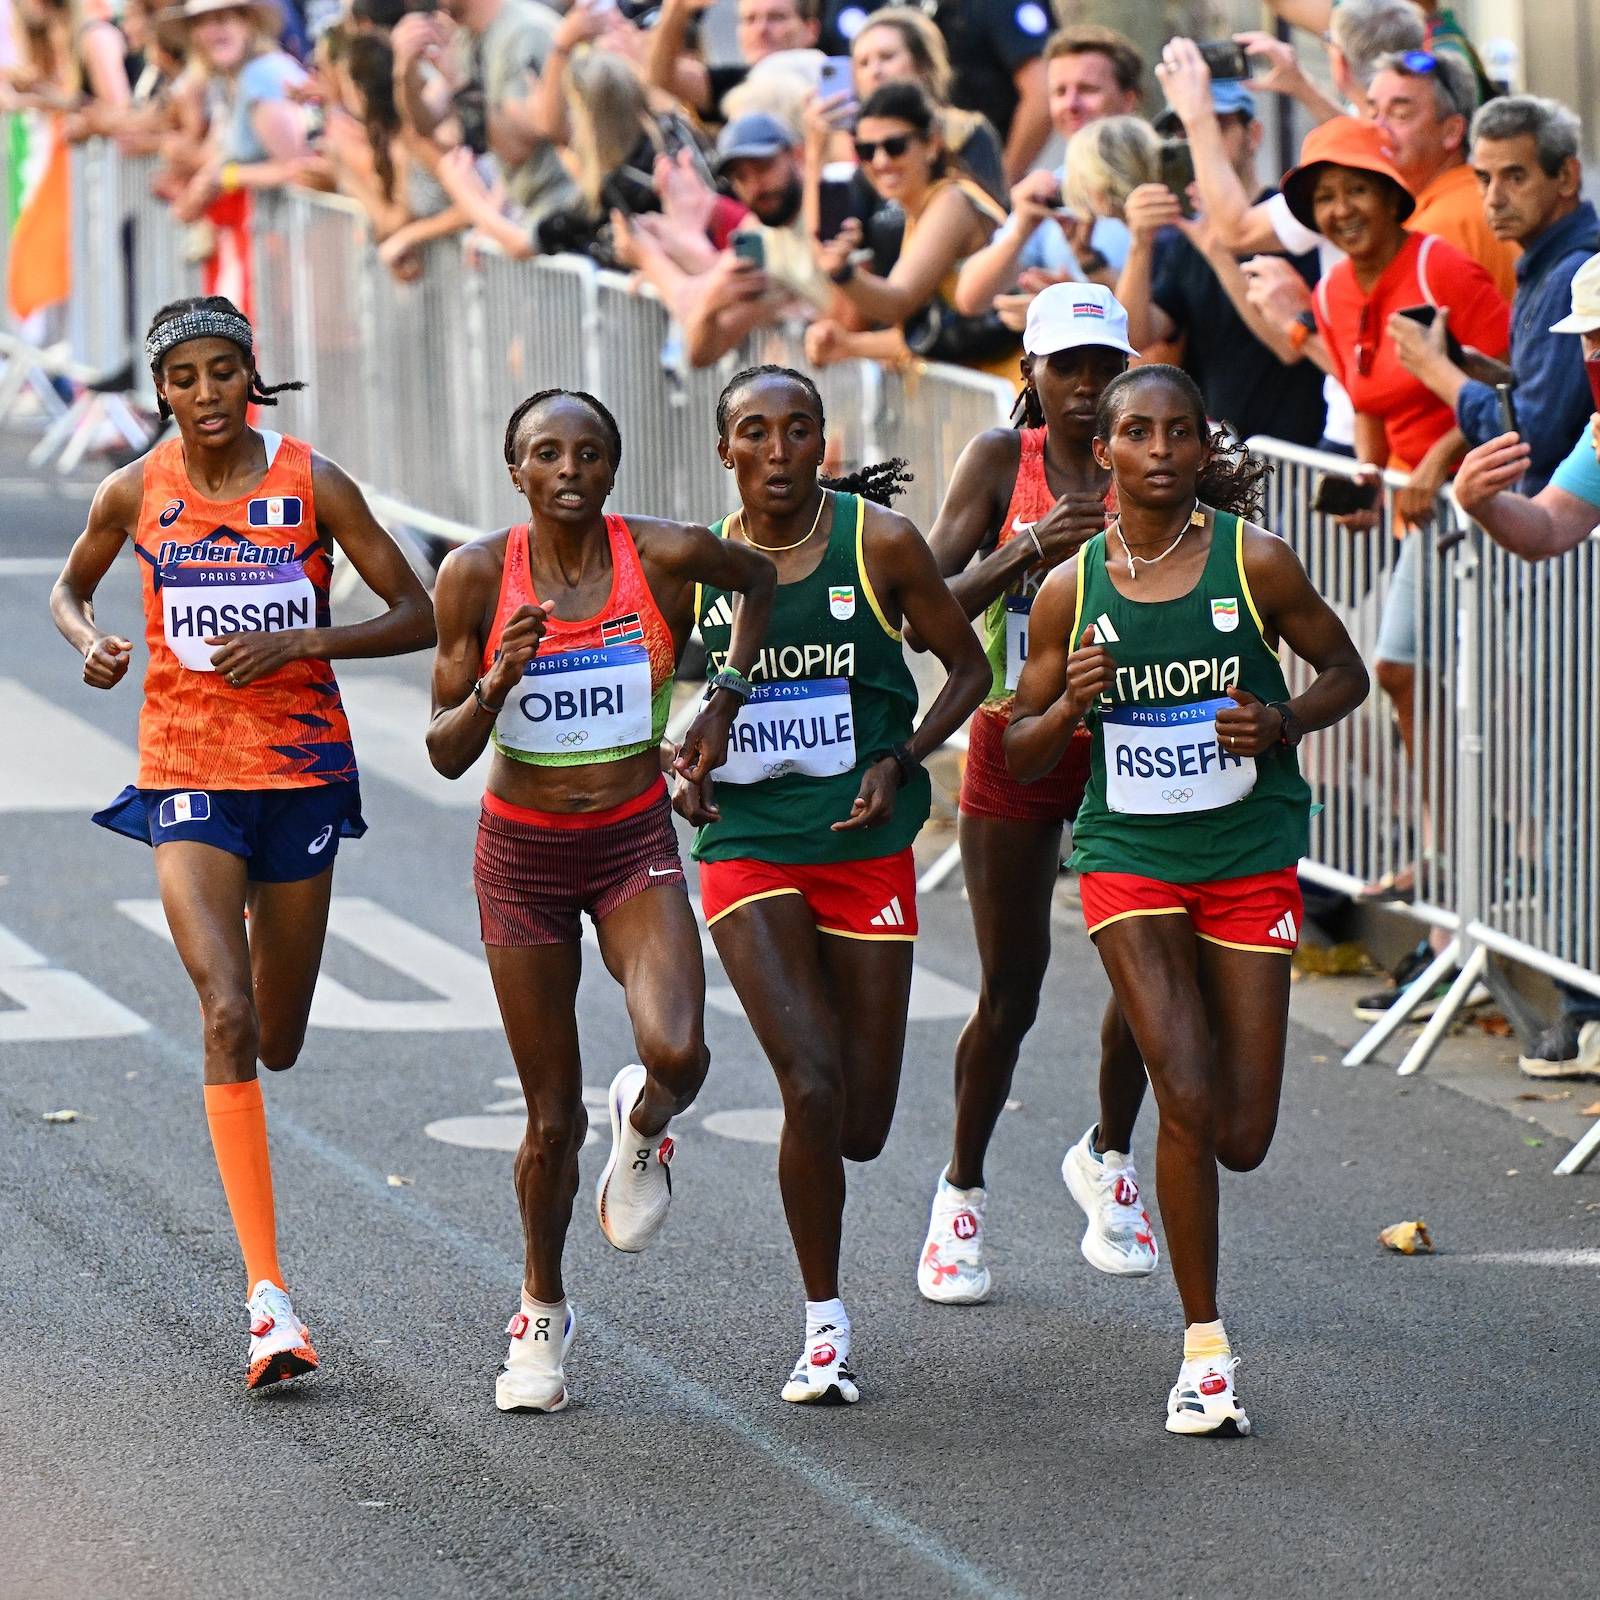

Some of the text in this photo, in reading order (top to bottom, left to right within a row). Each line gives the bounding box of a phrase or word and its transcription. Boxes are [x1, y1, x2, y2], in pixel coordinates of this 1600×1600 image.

[200, 570, 274, 582] PARIS 2024
[171, 597, 308, 637] HASSAN
[530, 654, 608, 671] PARIS 2024
[774, 686, 808, 697] 2024
[520, 684, 624, 723] OBIRI
[1132, 708, 1206, 722] PARIS 2024
